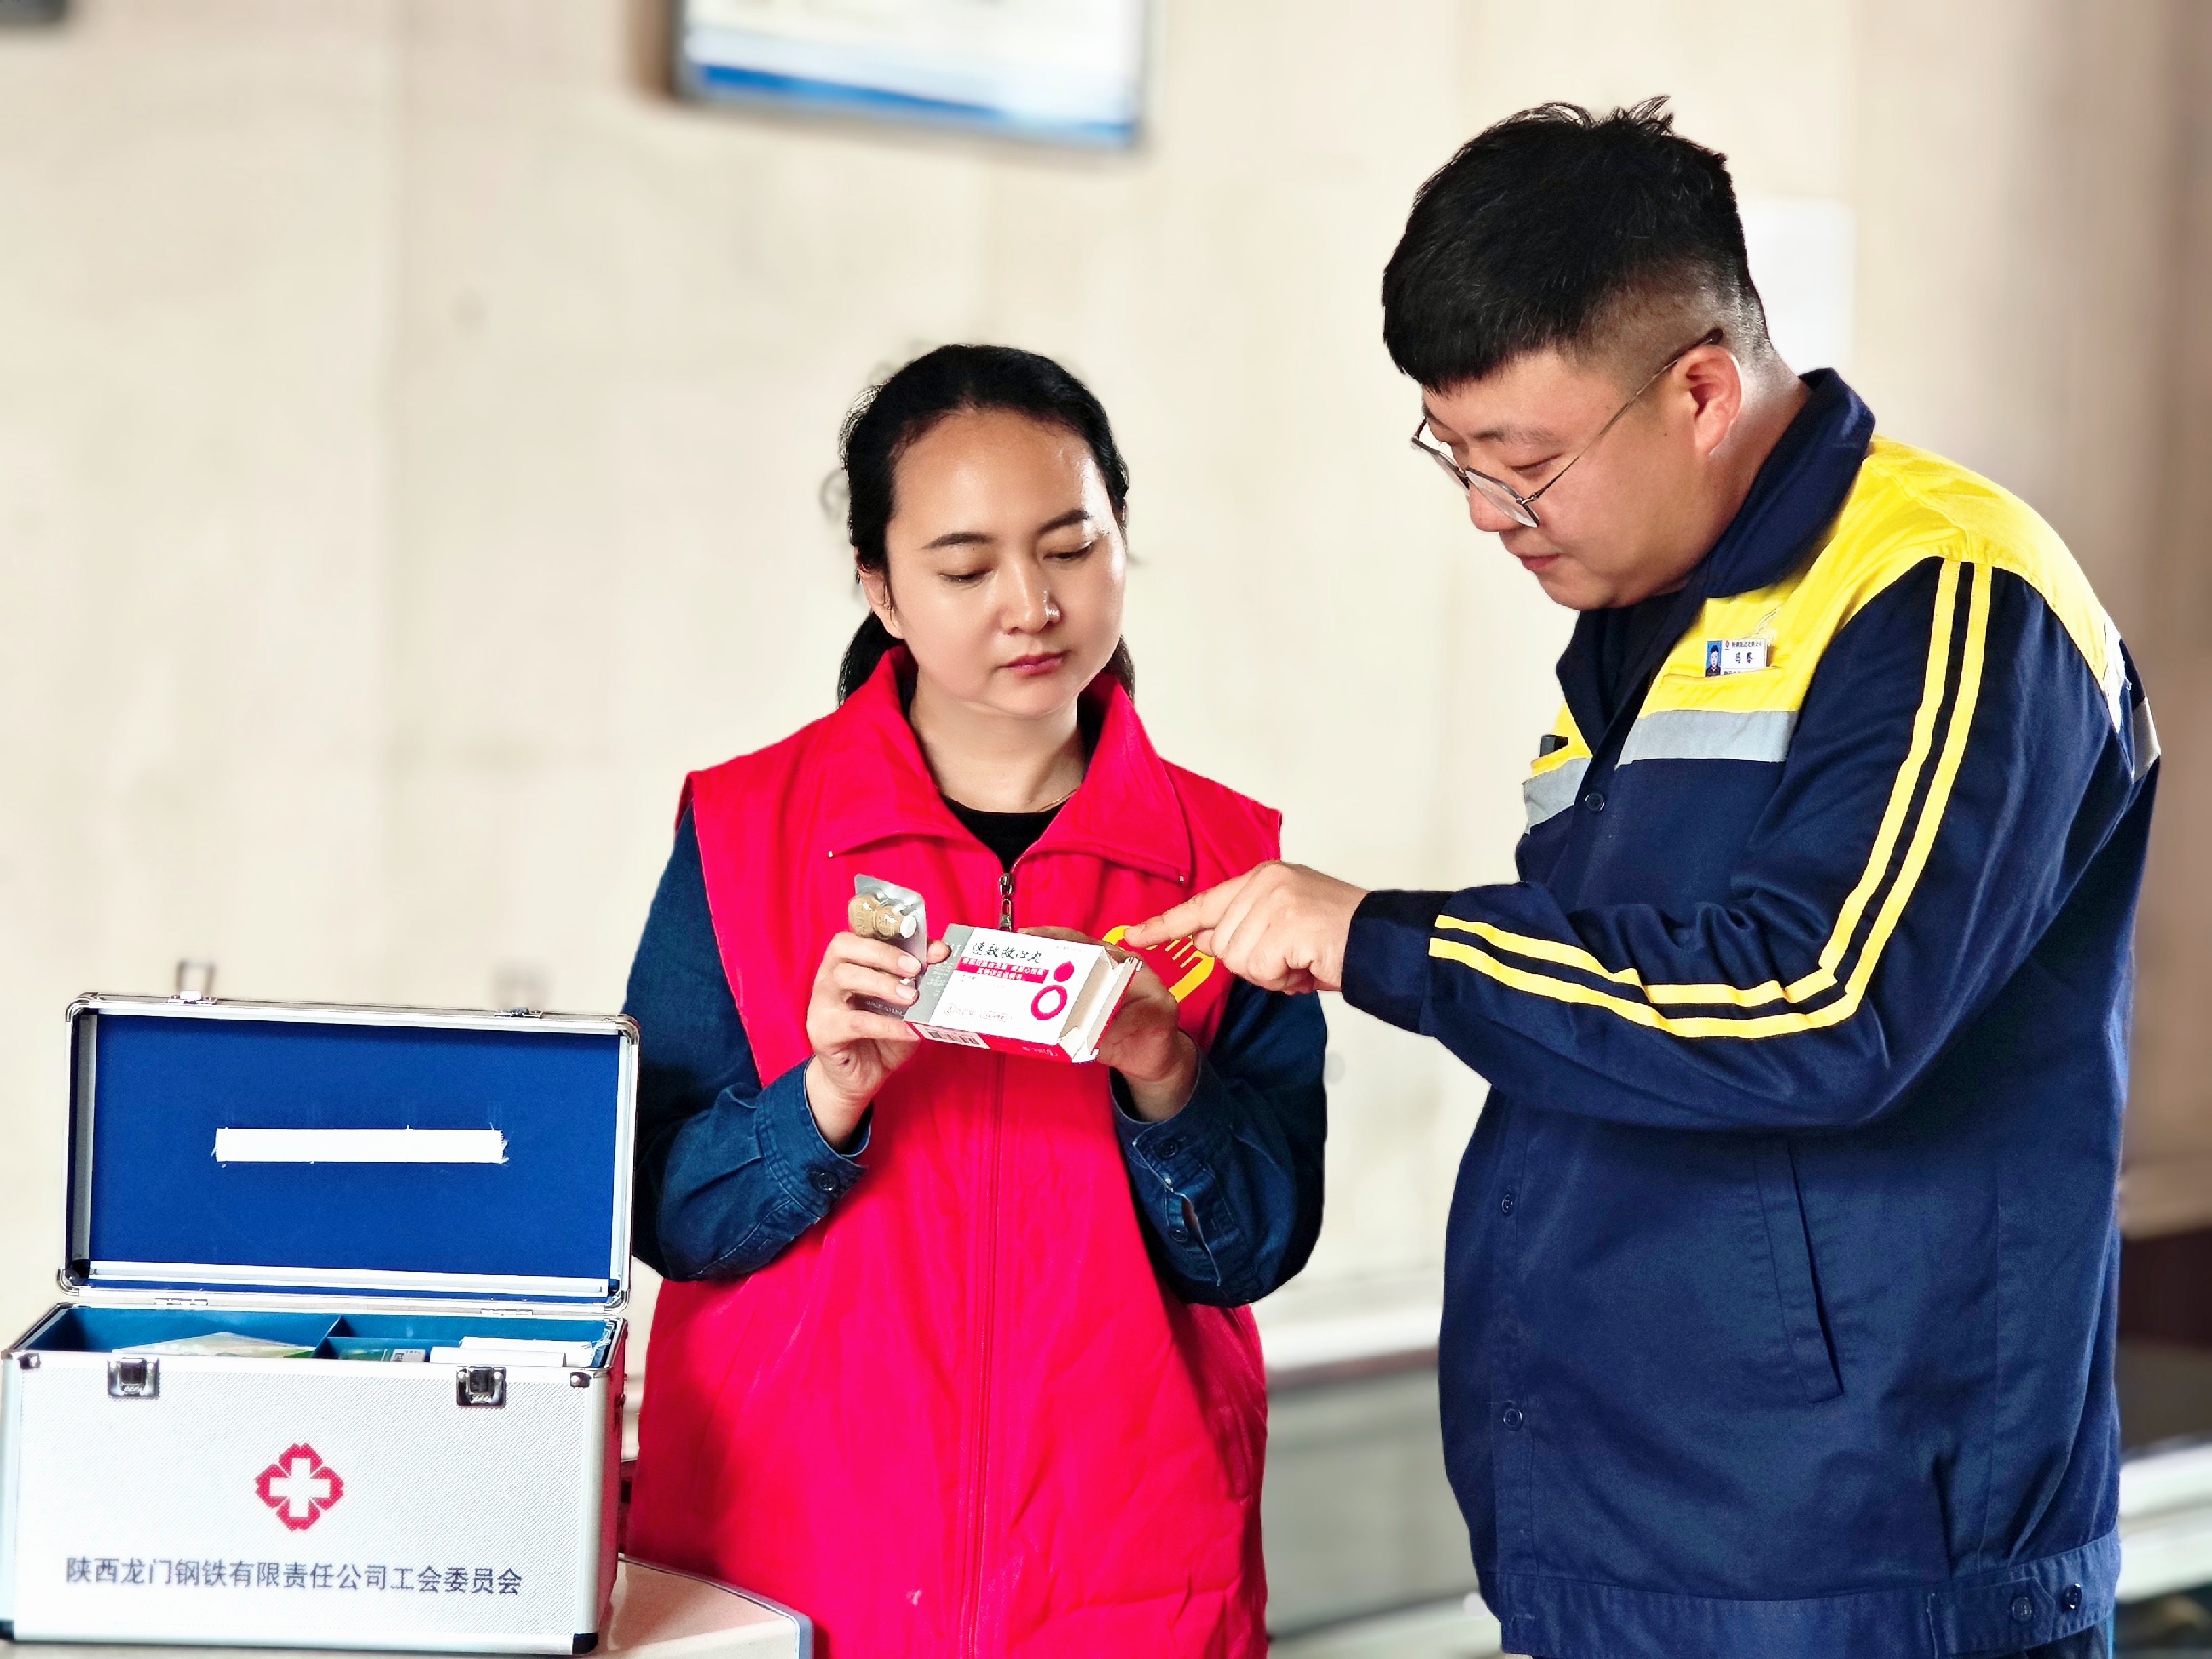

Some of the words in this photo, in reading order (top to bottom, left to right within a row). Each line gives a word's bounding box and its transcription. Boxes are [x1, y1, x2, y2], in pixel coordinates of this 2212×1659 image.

[66, 1556, 522, 1595] 陕西龙门钢铁有限责任公司工会委员会
